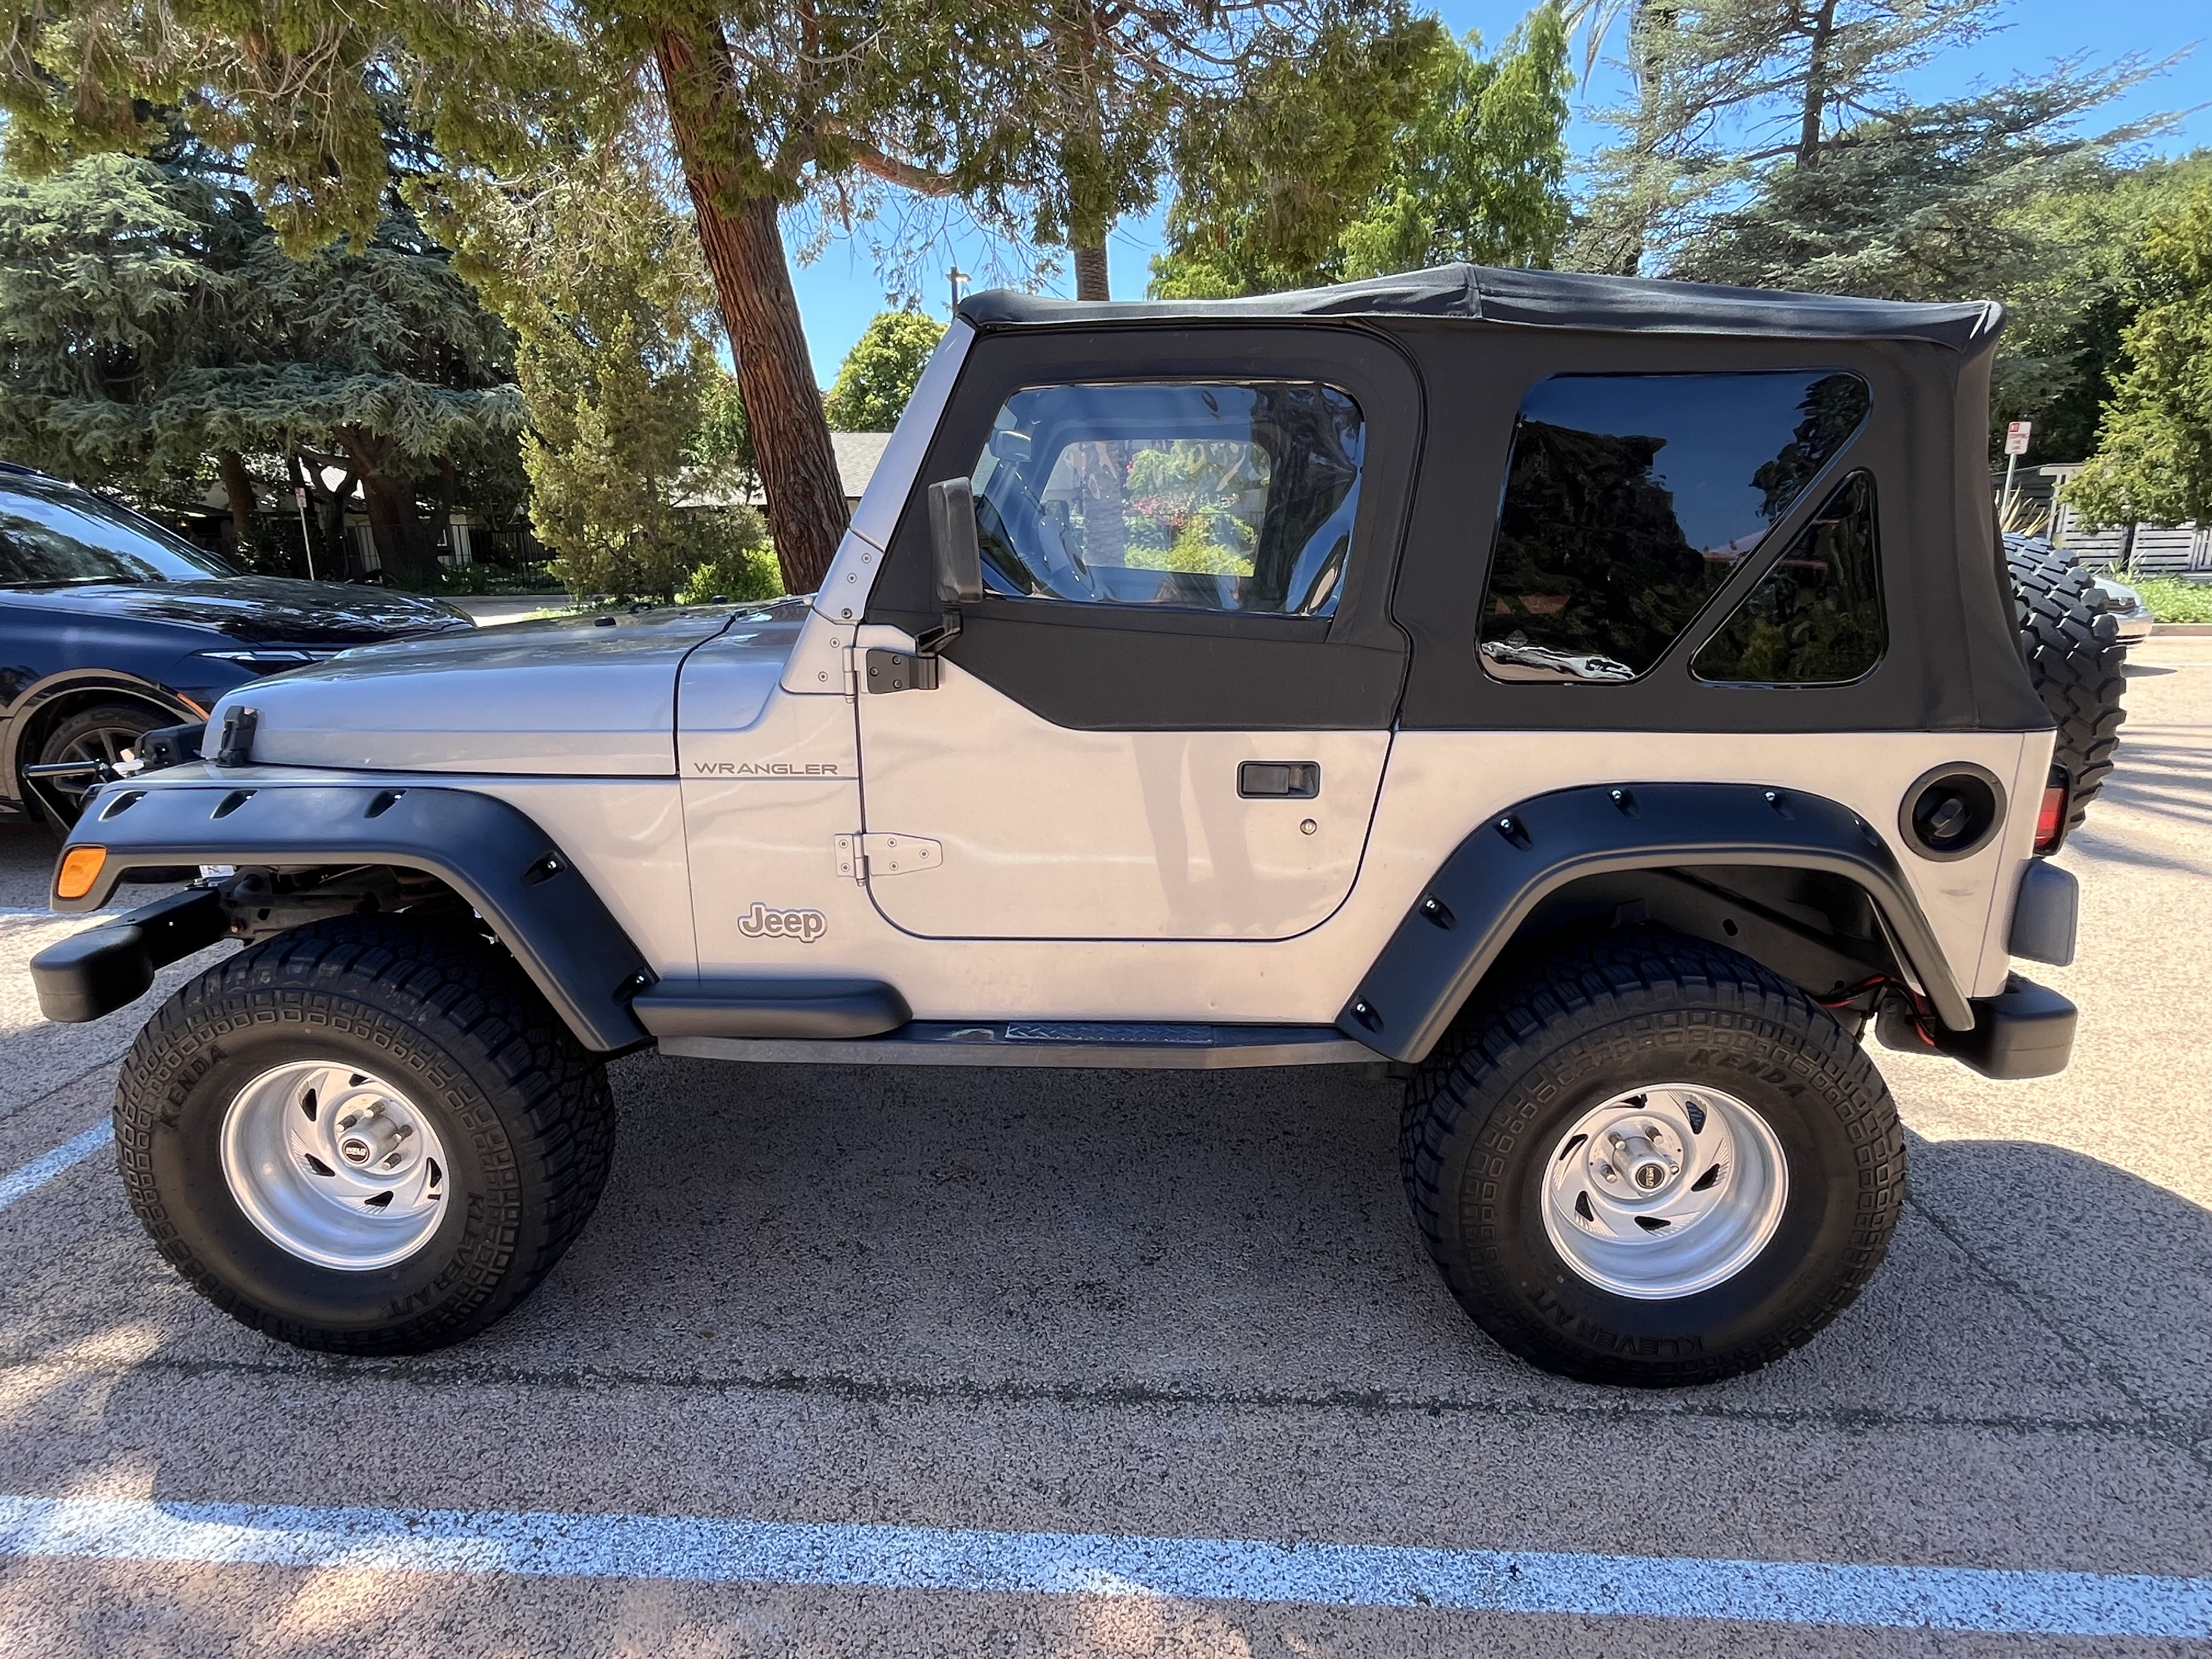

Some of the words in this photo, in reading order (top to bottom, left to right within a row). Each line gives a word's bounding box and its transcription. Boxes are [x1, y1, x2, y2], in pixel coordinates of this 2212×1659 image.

[693, 762, 838, 775] WRANGLER
[742, 906, 823, 938] Jeep
[157, 1045, 229, 1131] KENDA
[1688, 1047, 1807, 1097] KENDA
[431, 1191, 483, 1289] KLEVER
[1576, 1318, 1704, 1357] KLEVER
